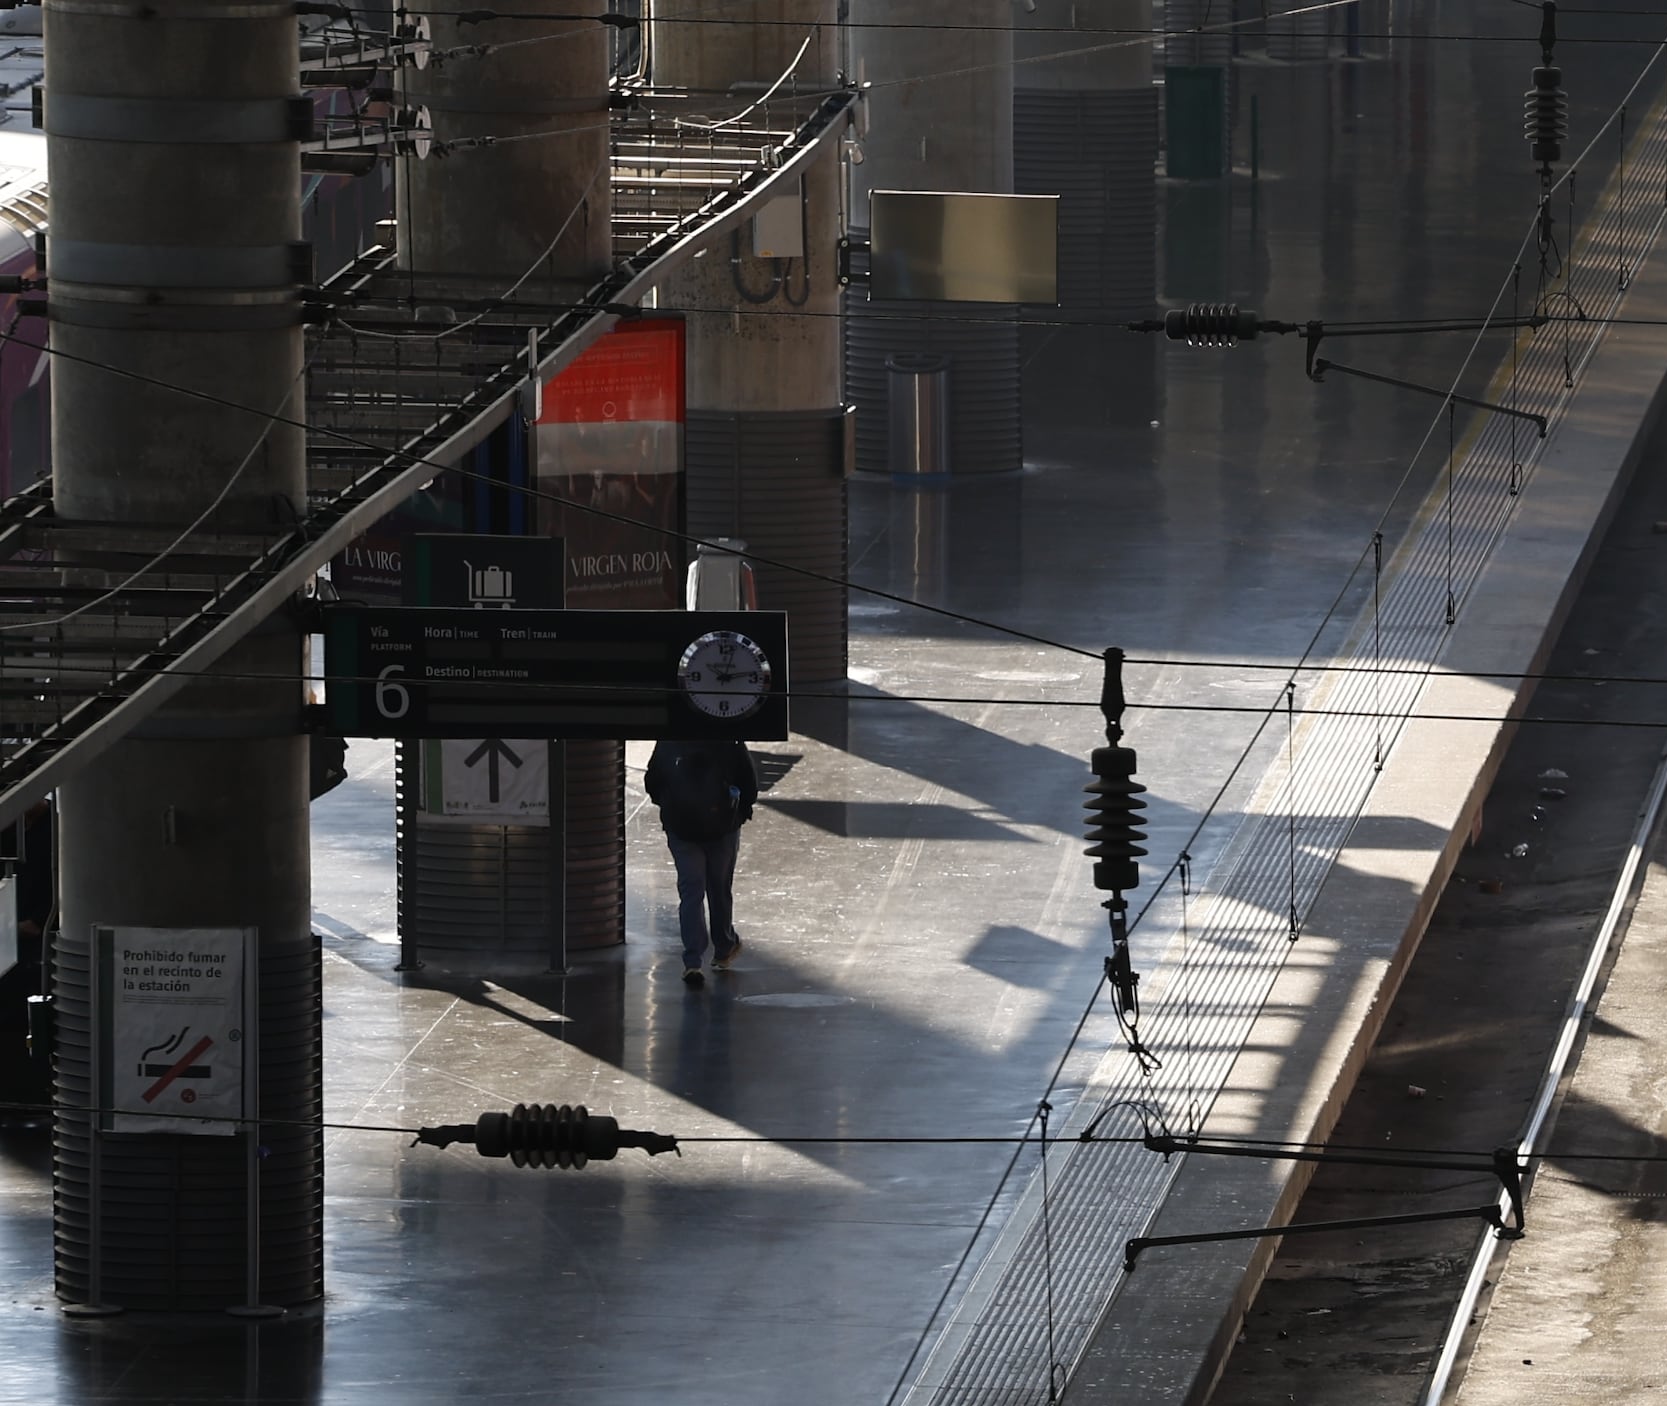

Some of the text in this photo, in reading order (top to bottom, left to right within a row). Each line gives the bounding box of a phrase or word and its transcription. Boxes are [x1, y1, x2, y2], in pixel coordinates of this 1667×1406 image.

[345, 546, 362, 567] LA
[570, 551, 672, 576] VIRGEN ROJA
[370, 626, 390, 638] Vía
[424, 627, 480, 639] Hora TIME
[500, 628, 557, 639] Tren TRAIN
[370, 643, 413, 651] PLATFORM
[425, 666, 528, 678] Destino DESTINATION
[375, 664, 410, 719] 6
[123, 950, 226, 963] Prohibido fumar
[123, 965, 222, 978] en el recinto de
[123, 980, 190, 993] la estación
